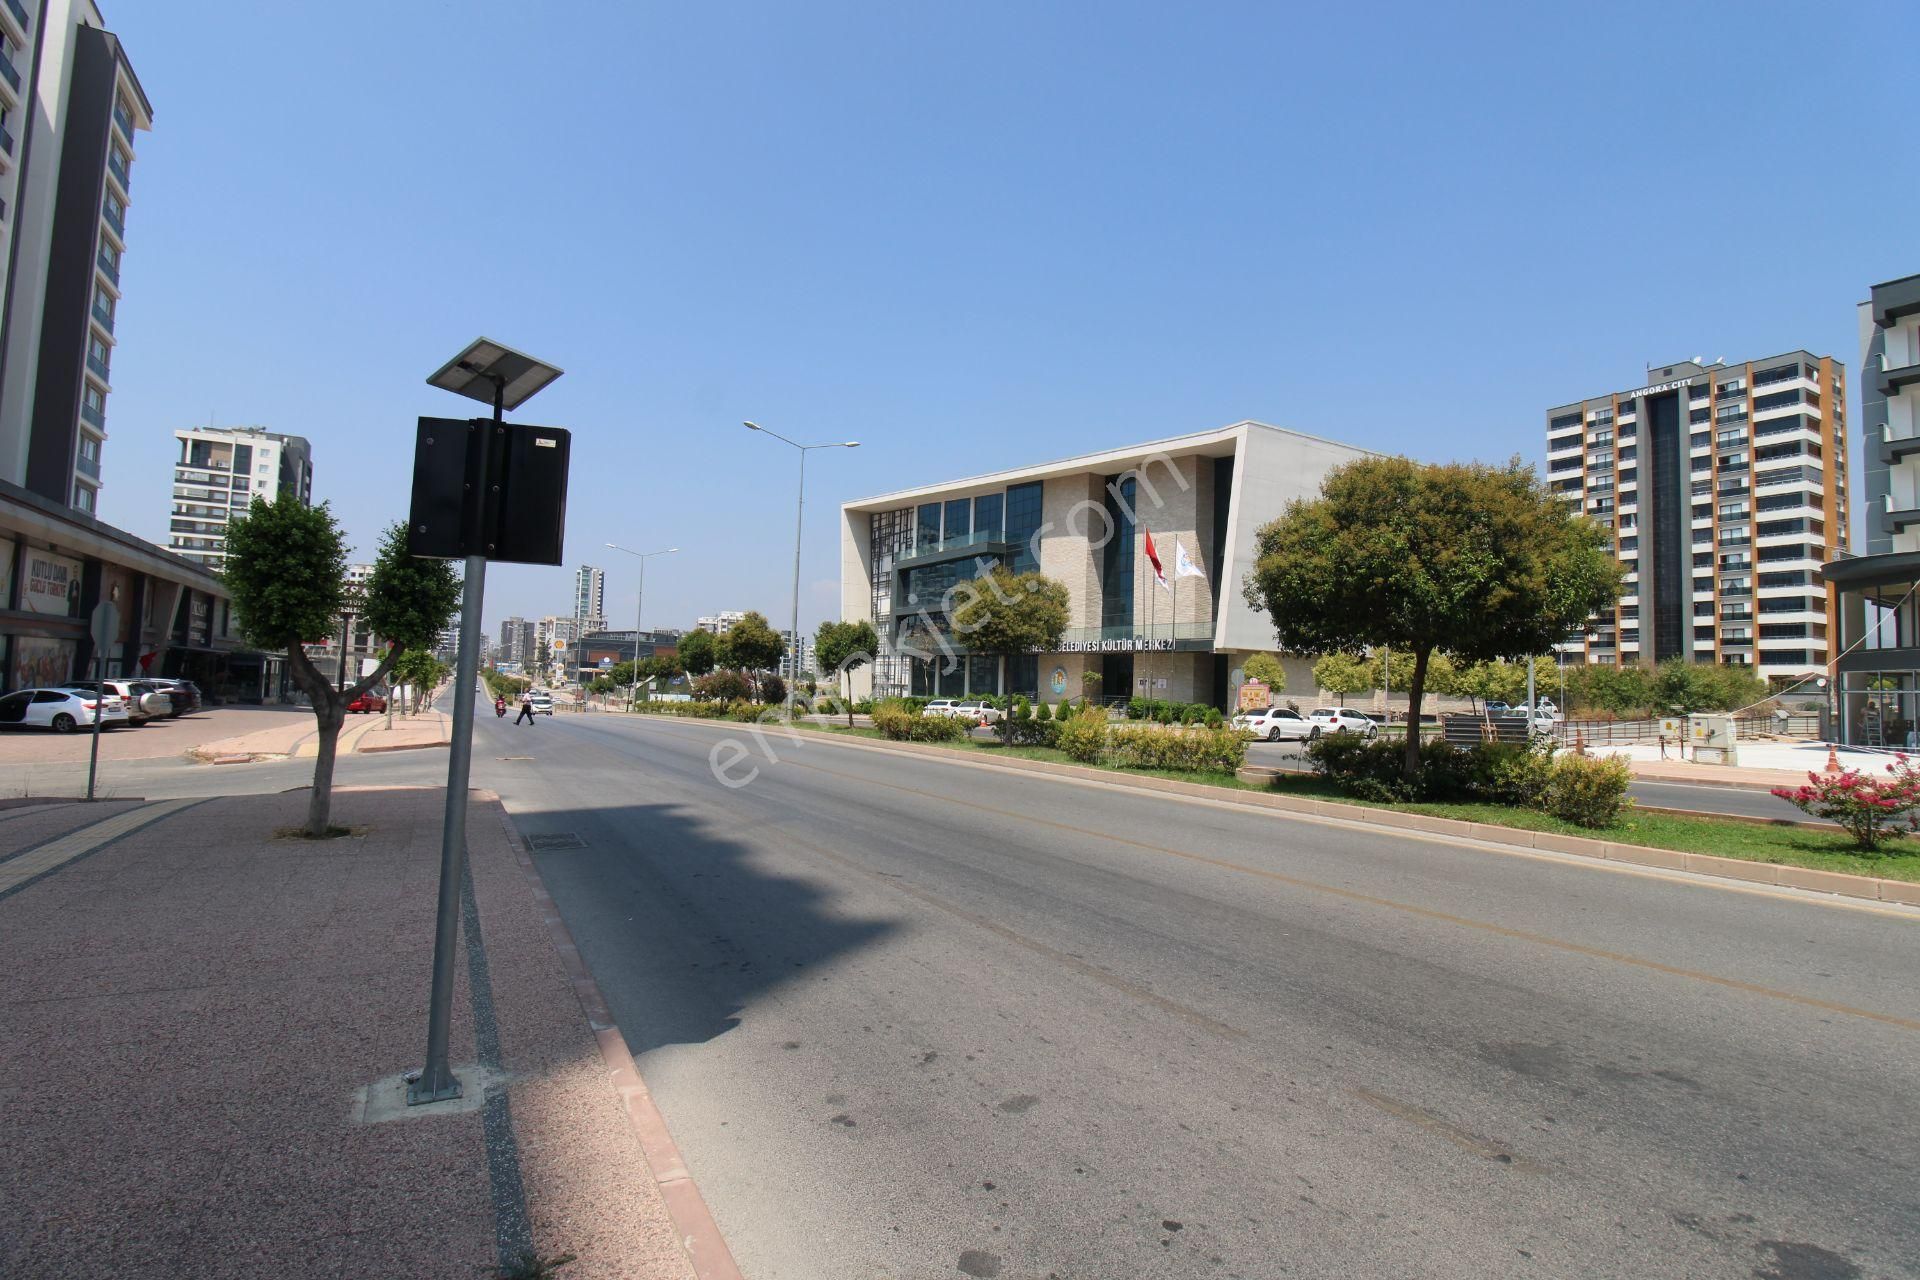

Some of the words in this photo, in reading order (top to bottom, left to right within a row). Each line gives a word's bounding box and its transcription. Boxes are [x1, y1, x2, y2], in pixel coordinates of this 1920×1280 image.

[1630, 385, 1667, 399] ANGORA
[1671, 378, 1693, 390] CITY
[1102, 638, 1132, 651] KÜLTÜR
